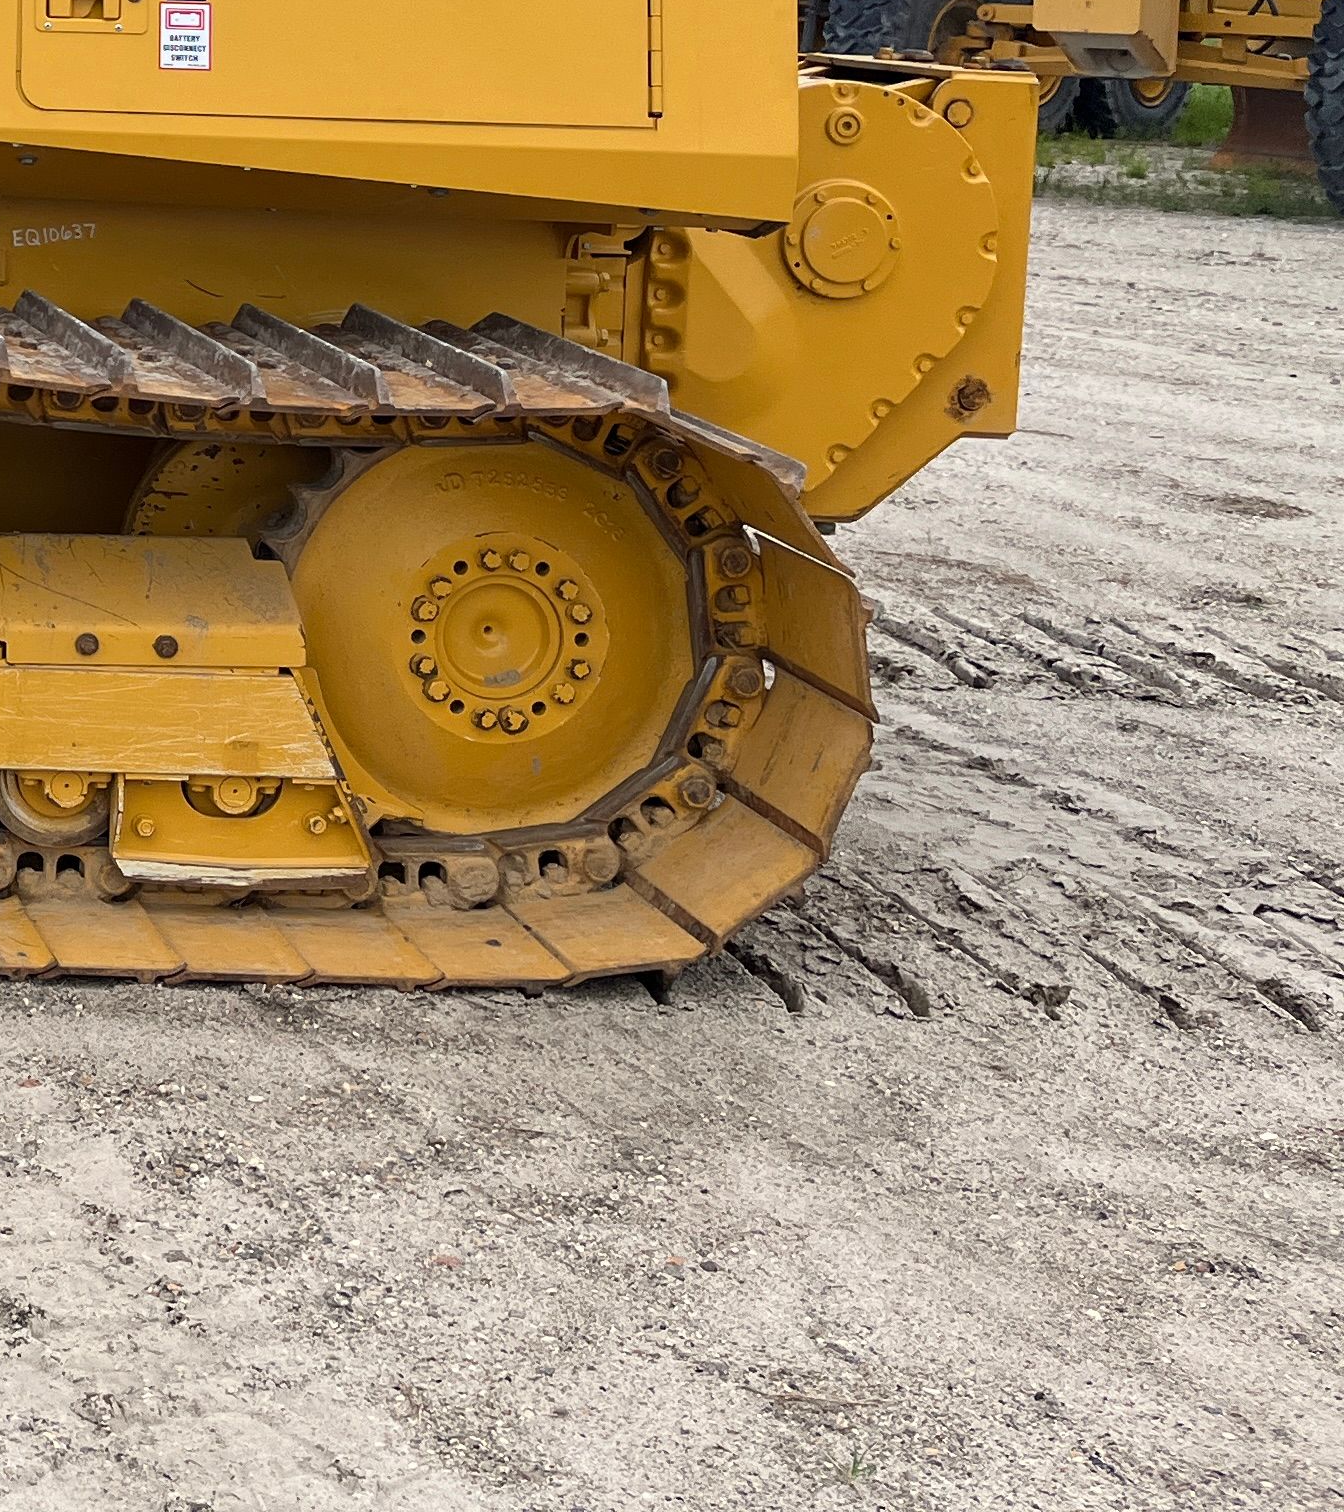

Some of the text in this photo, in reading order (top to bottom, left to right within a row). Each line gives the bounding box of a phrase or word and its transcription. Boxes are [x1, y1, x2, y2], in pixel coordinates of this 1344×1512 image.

[169, 34, 201, 43] BATTERY
[163, 44, 207, 53] DISCONNECT
[170, 54, 200, 63] SWITCH
[12, 223, 97, 248] EQ10637
